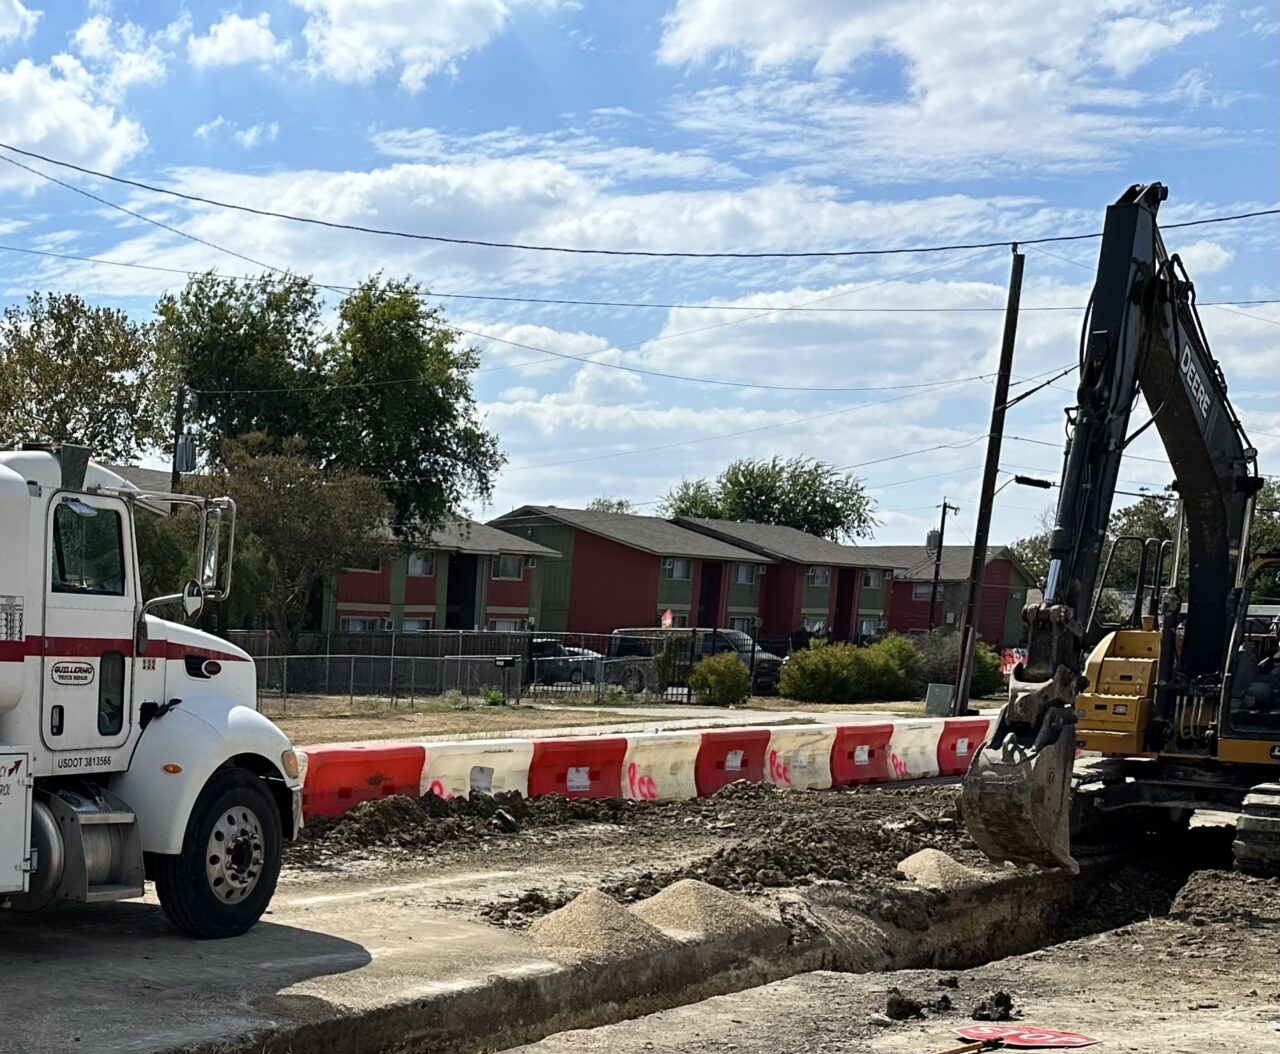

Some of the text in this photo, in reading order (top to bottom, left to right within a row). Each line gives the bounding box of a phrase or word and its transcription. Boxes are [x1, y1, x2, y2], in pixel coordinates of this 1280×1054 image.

[1180, 344, 1211, 419] DEERE
[57, 757, 83, 769] USDOT
[966, 1025, 1088, 1044] STOP
